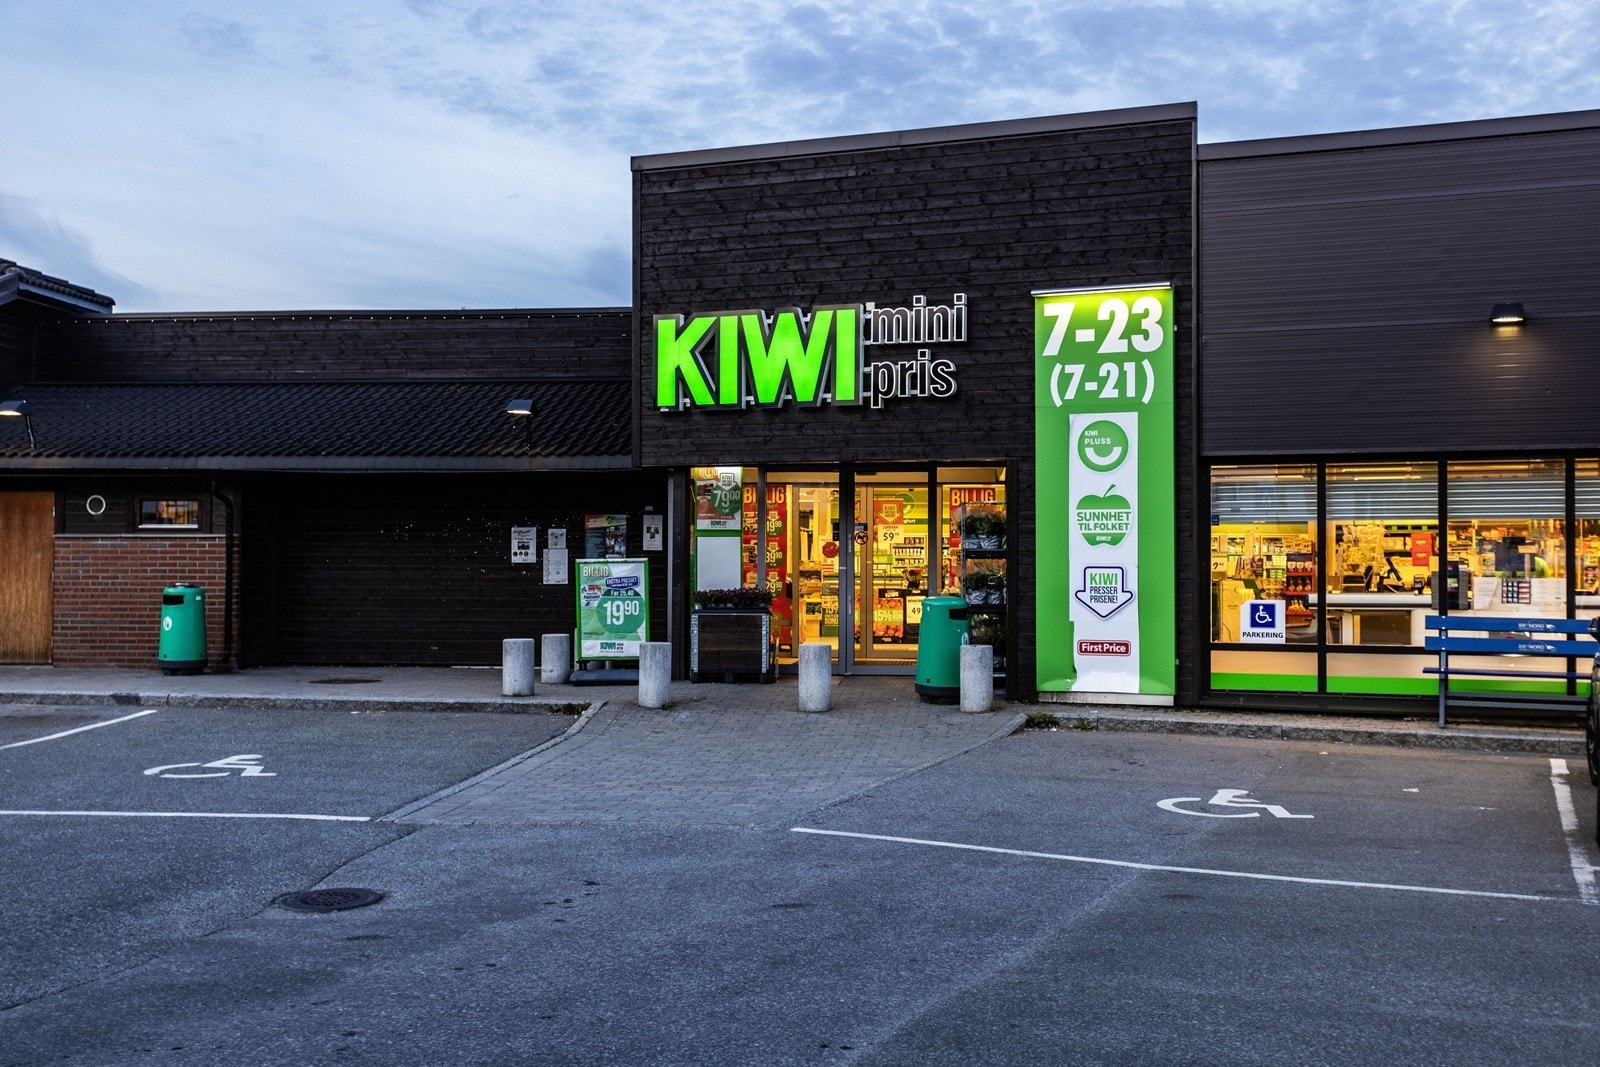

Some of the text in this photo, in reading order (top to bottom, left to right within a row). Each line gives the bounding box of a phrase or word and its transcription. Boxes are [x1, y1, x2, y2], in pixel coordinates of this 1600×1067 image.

[871, 292, 968, 345] mini
[1042, 296, 1164, 356] 7-23
[656, 308, 857, 408] KIWI
[870, 349, 957, 409] pris
[1050, 358, 1155, 408] (7-21)
[1084, 437, 1112, 445] PLUSS
[1076, 511, 1132, 522] SUNNHET
[1078, 522, 1131, 531] TIL FOLKET
[583, 565, 609, 577] BILLIG
[1089, 572, 1118, 586] KIWI
[1089, 586, 1118, 595] PRESSER
[1089, 595, 1118, 604] PRISENE!
[1242, 631, 1284, 639] PARKERING
[1081, 642, 1127, 653] First Price
